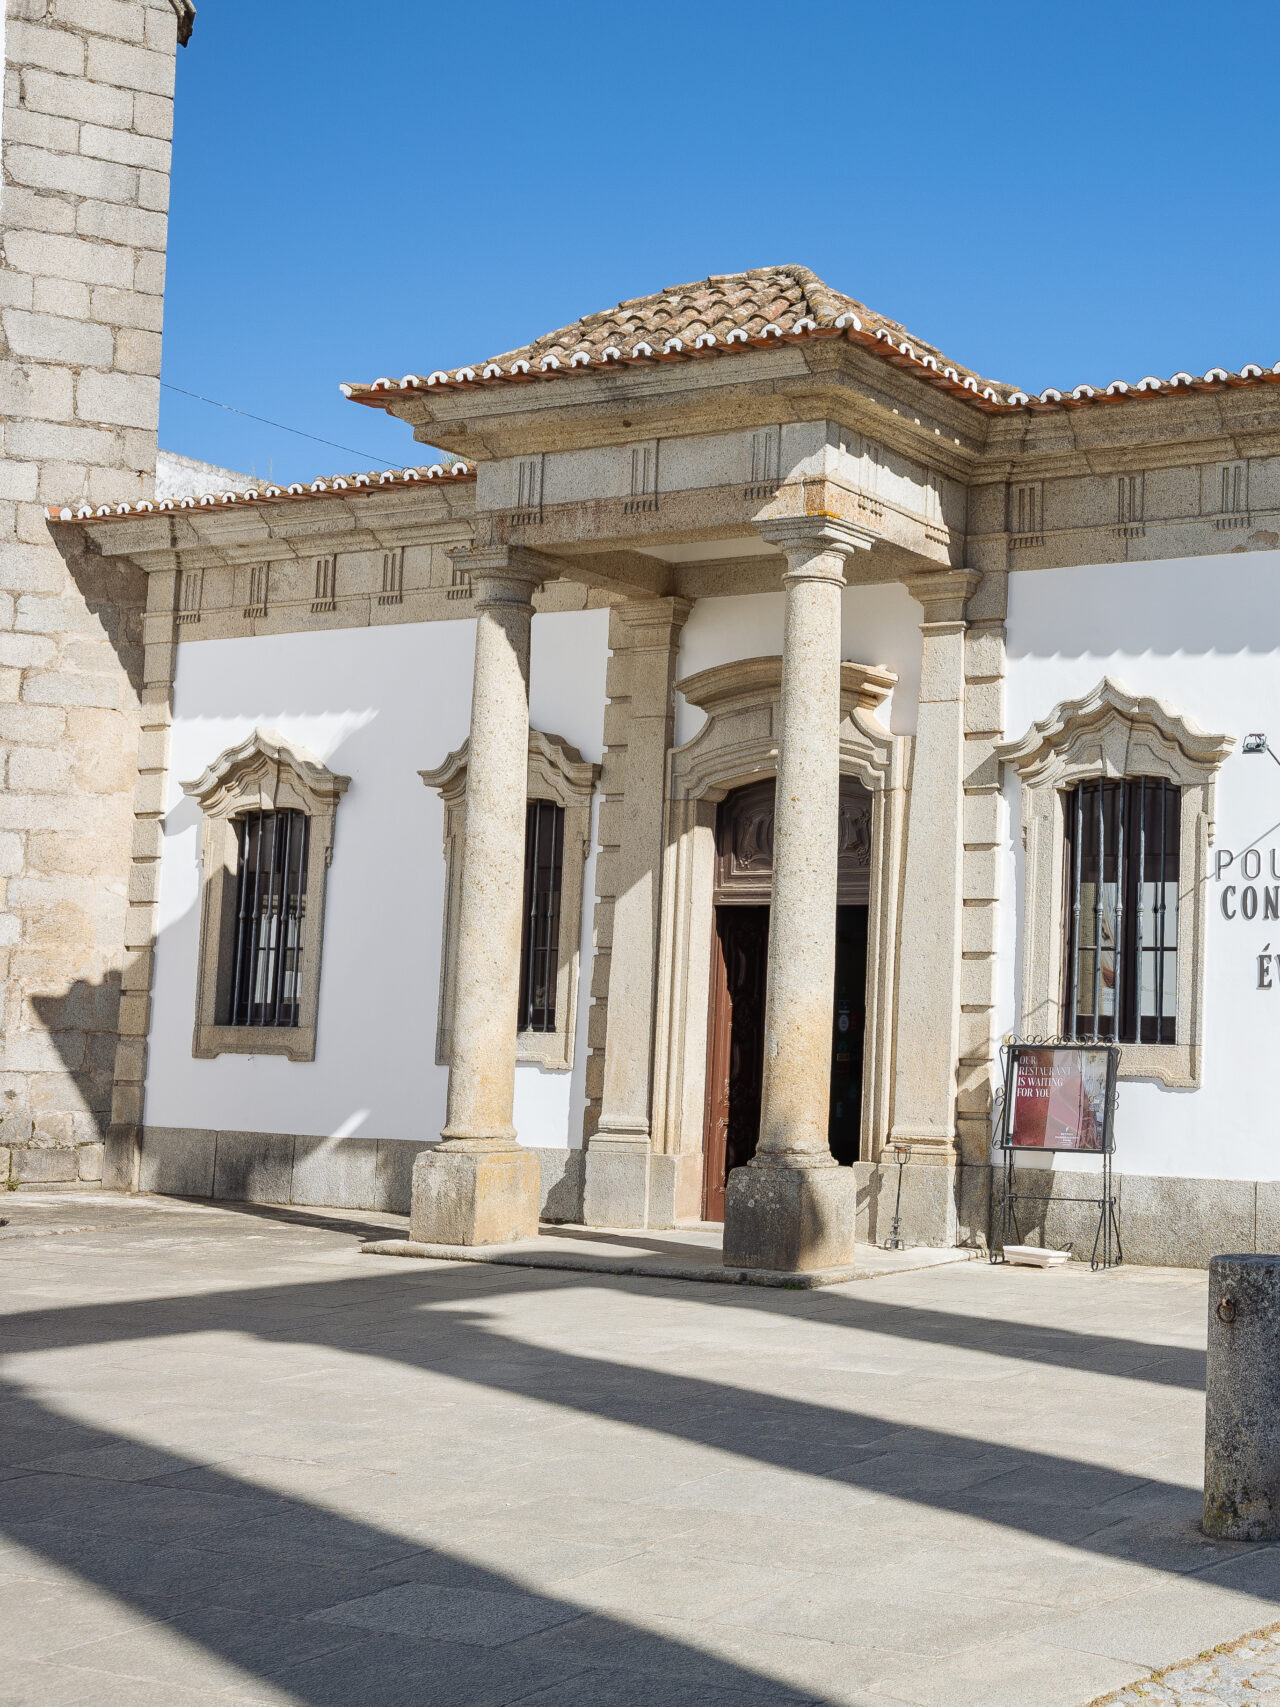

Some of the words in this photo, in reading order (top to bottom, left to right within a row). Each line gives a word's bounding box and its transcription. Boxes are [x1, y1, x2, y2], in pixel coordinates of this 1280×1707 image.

[1020, 1056, 1036, 1064] OUR
[1019, 1066, 1072, 1075] RESTAURANT
[1018, 1077, 1026, 1086] IS
[1028, 1077, 1063, 1087] WAITING
[1017, 1088, 1033, 1097] FOR
[1036, 1088, 1050, 1097] YOU
